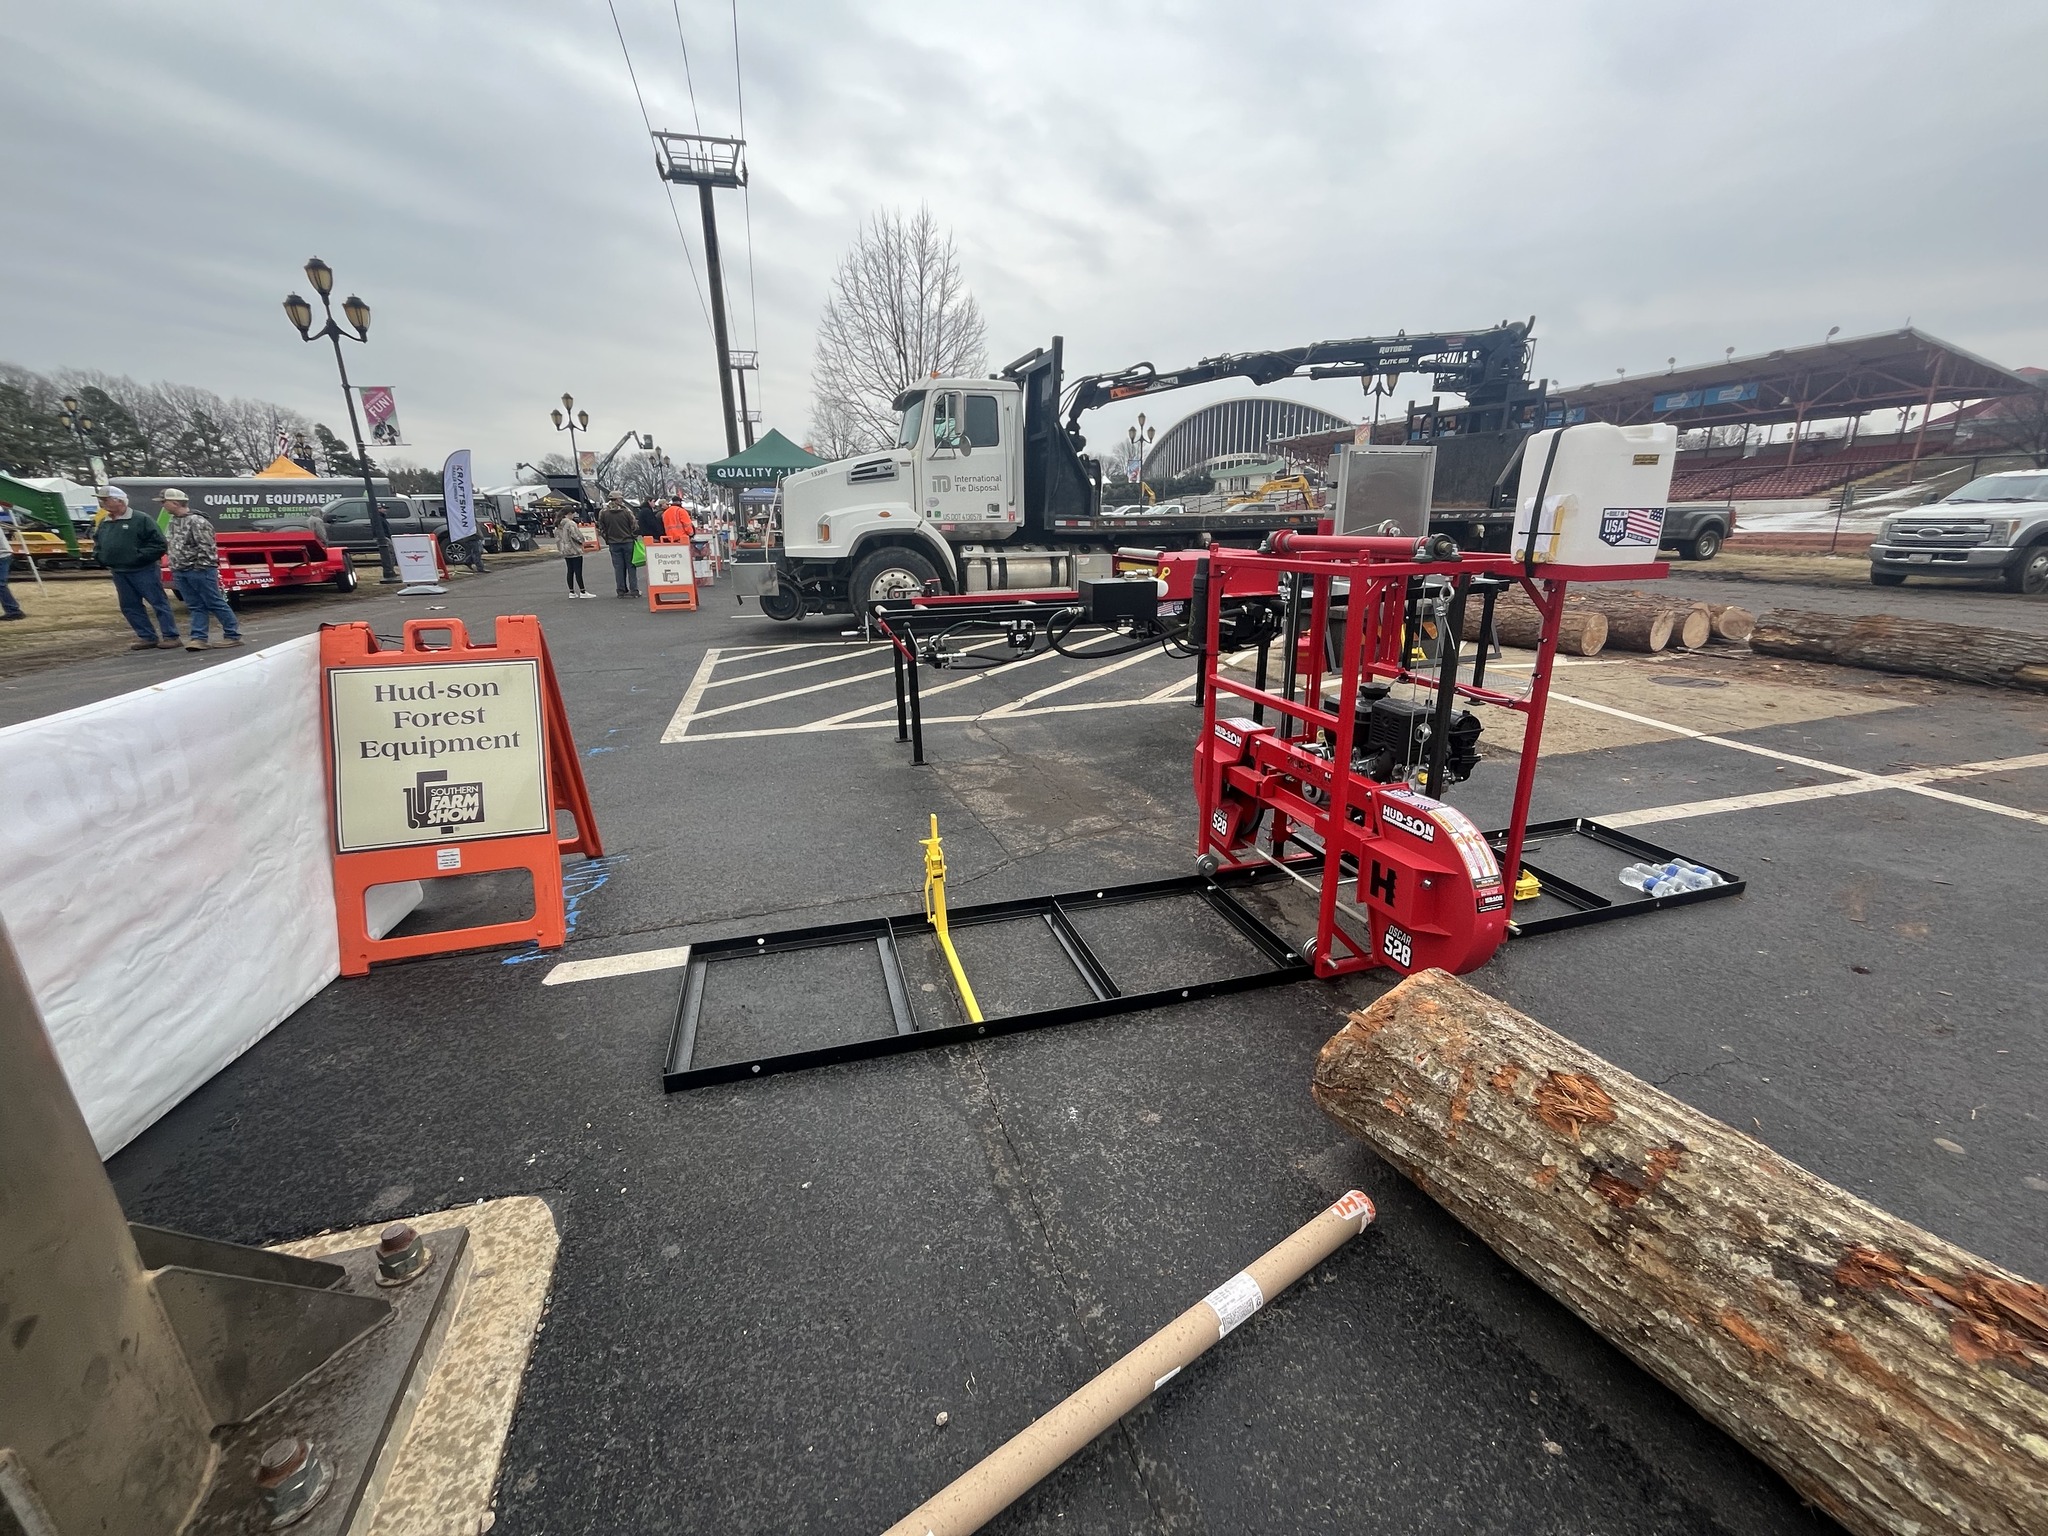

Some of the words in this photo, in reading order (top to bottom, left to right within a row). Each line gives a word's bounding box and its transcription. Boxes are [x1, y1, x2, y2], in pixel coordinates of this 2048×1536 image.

[717, 468, 771, 478] QUALITY
[954, 474, 1002, 482] International
[456, 465, 469, 527] KRAFTSMAN
[955, 484, 966, 492] Tie
[968, 484, 1000, 493] Disposal
[204, 494, 259, 505] QUALITY
[1604, 520, 1624, 532] USA
[374, 681, 499, 702] Hud-son
[393, 707, 485, 729] Forest
[359, 731, 520, 761] Equipment
[431, 785, 478, 796] SOUTHERN
[430, 793, 479, 810] FARM
[427, 807, 479, 824] SHOW
[1212, 813, 1228, 835] 528
[1383, 804, 1434, 838] HUD-SON
[1388, 925, 1412, 945] OSCAR
[1384, 933, 1411, 966] 528
